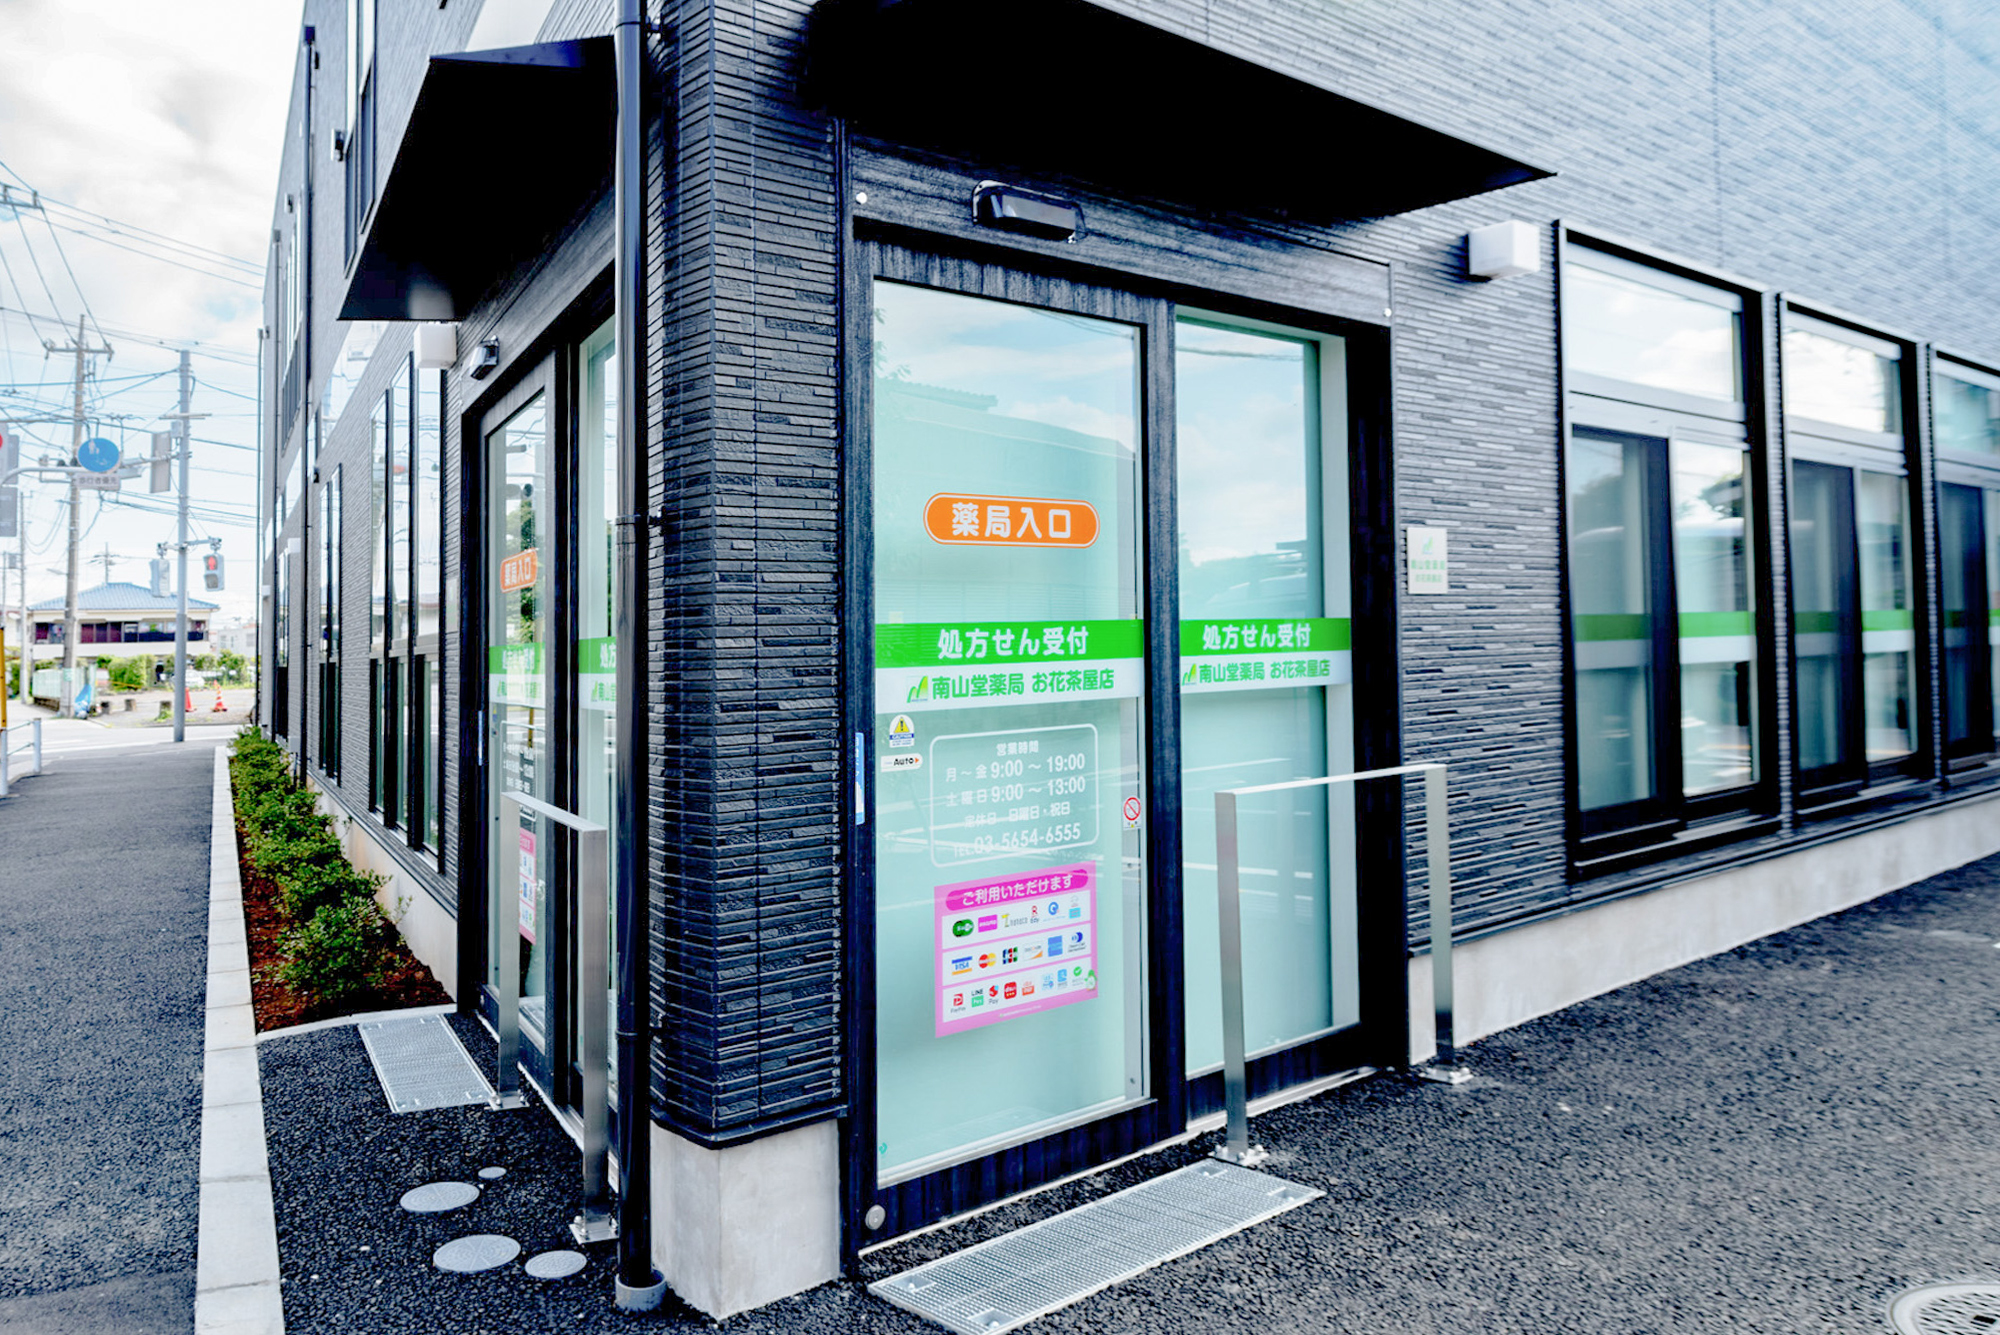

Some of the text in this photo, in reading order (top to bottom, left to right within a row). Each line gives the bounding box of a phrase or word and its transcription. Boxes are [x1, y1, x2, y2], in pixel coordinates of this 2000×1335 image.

[952, 502, 1071, 538] 薬局入口
[938, 626, 1088, 659] 処方せん受付
[1202, 623, 1311, 650] 処方せん受付
[932, 669, 1114, 700] 南山堂薬局 お花茶屋店
[1199, 659, 1330, 683] 南山堂薬局 お花茶屋店
[996, 740, 1039, 756] 営業時間
[991, 759, 1023, 779] 9:00
[1047, 753, 1085, 772] 19:00
[991, 783, 1023, 803] 9:00
[1048, 776, 1086, 796] 13:00
[962, 874, 1073, 906] ご利用いただけます
[955, 962, 970, 970] VISA
[971, 988, 984, 996] LINE
